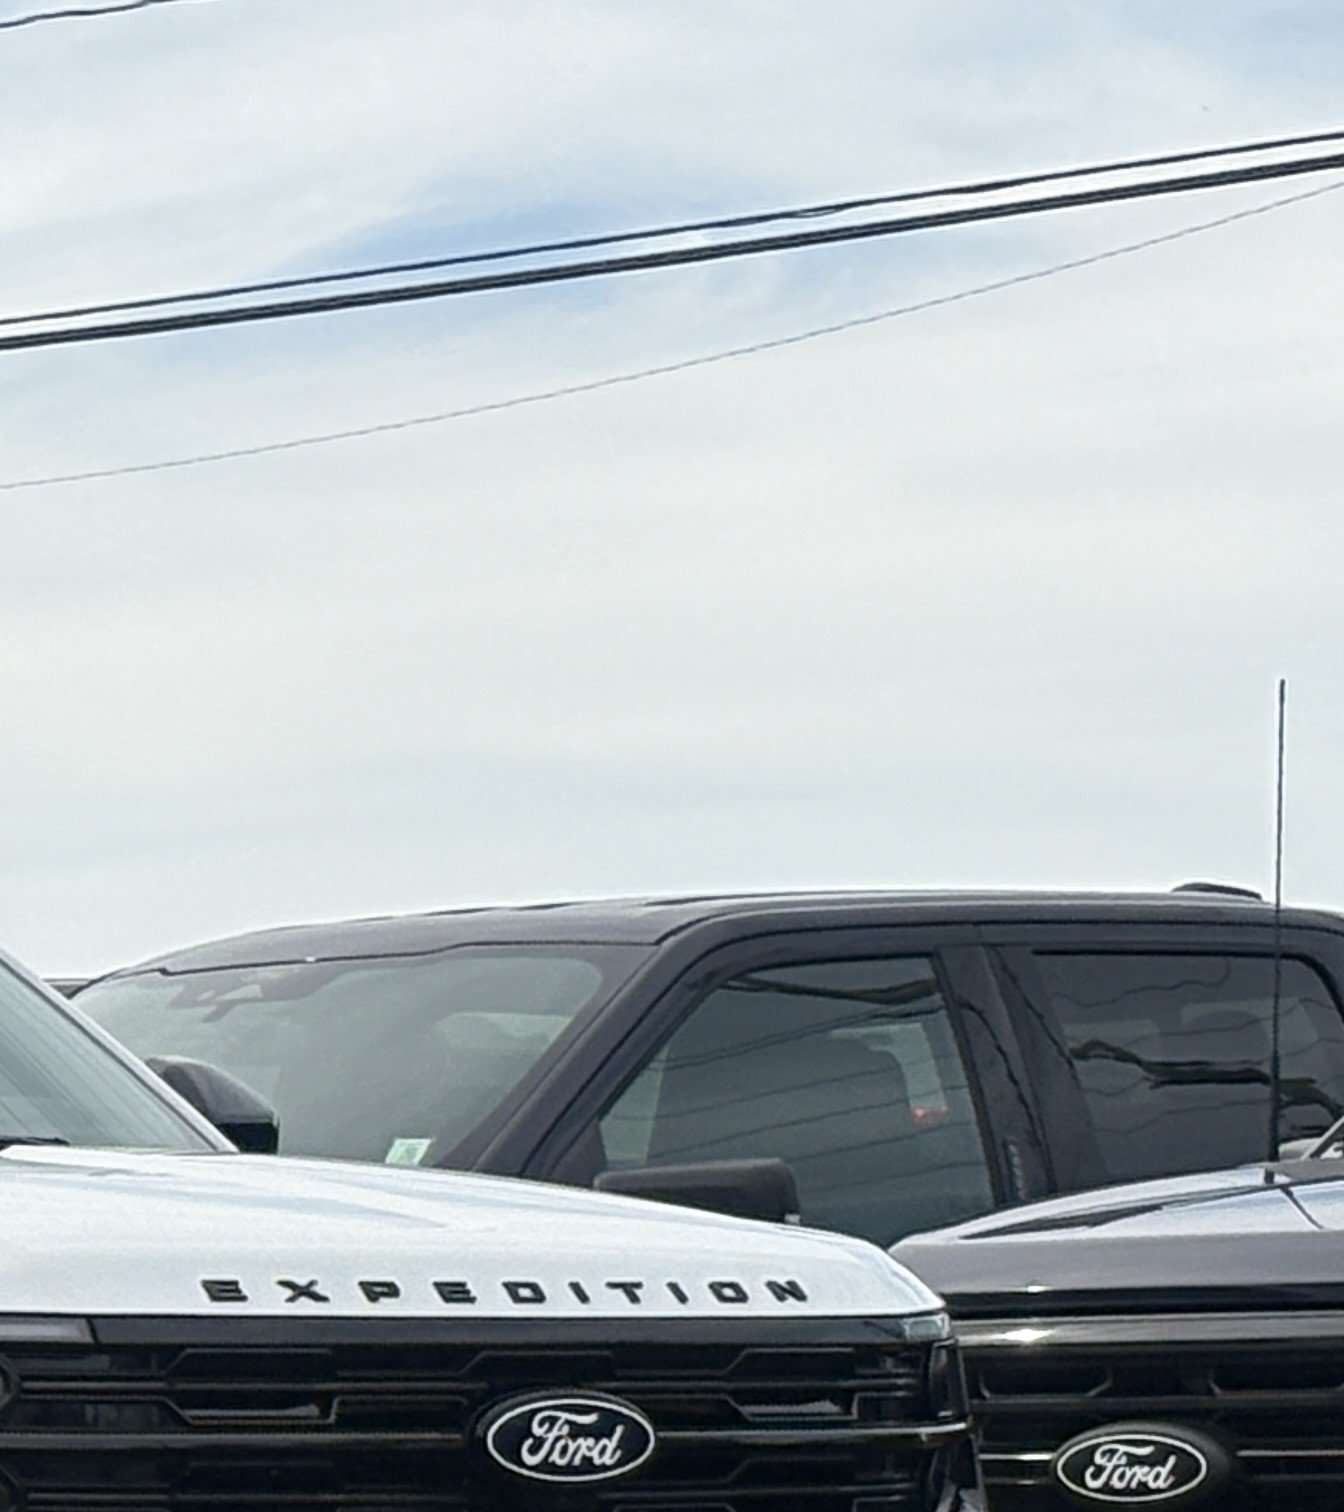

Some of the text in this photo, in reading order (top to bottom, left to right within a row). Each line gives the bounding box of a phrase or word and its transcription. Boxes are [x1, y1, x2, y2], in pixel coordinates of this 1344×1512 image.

[200, 1279, 810, 1305] EXPEDITION
[519, 1410, 623, 1469] Ford
[1084, 1443, 1178, 1490] Ford
